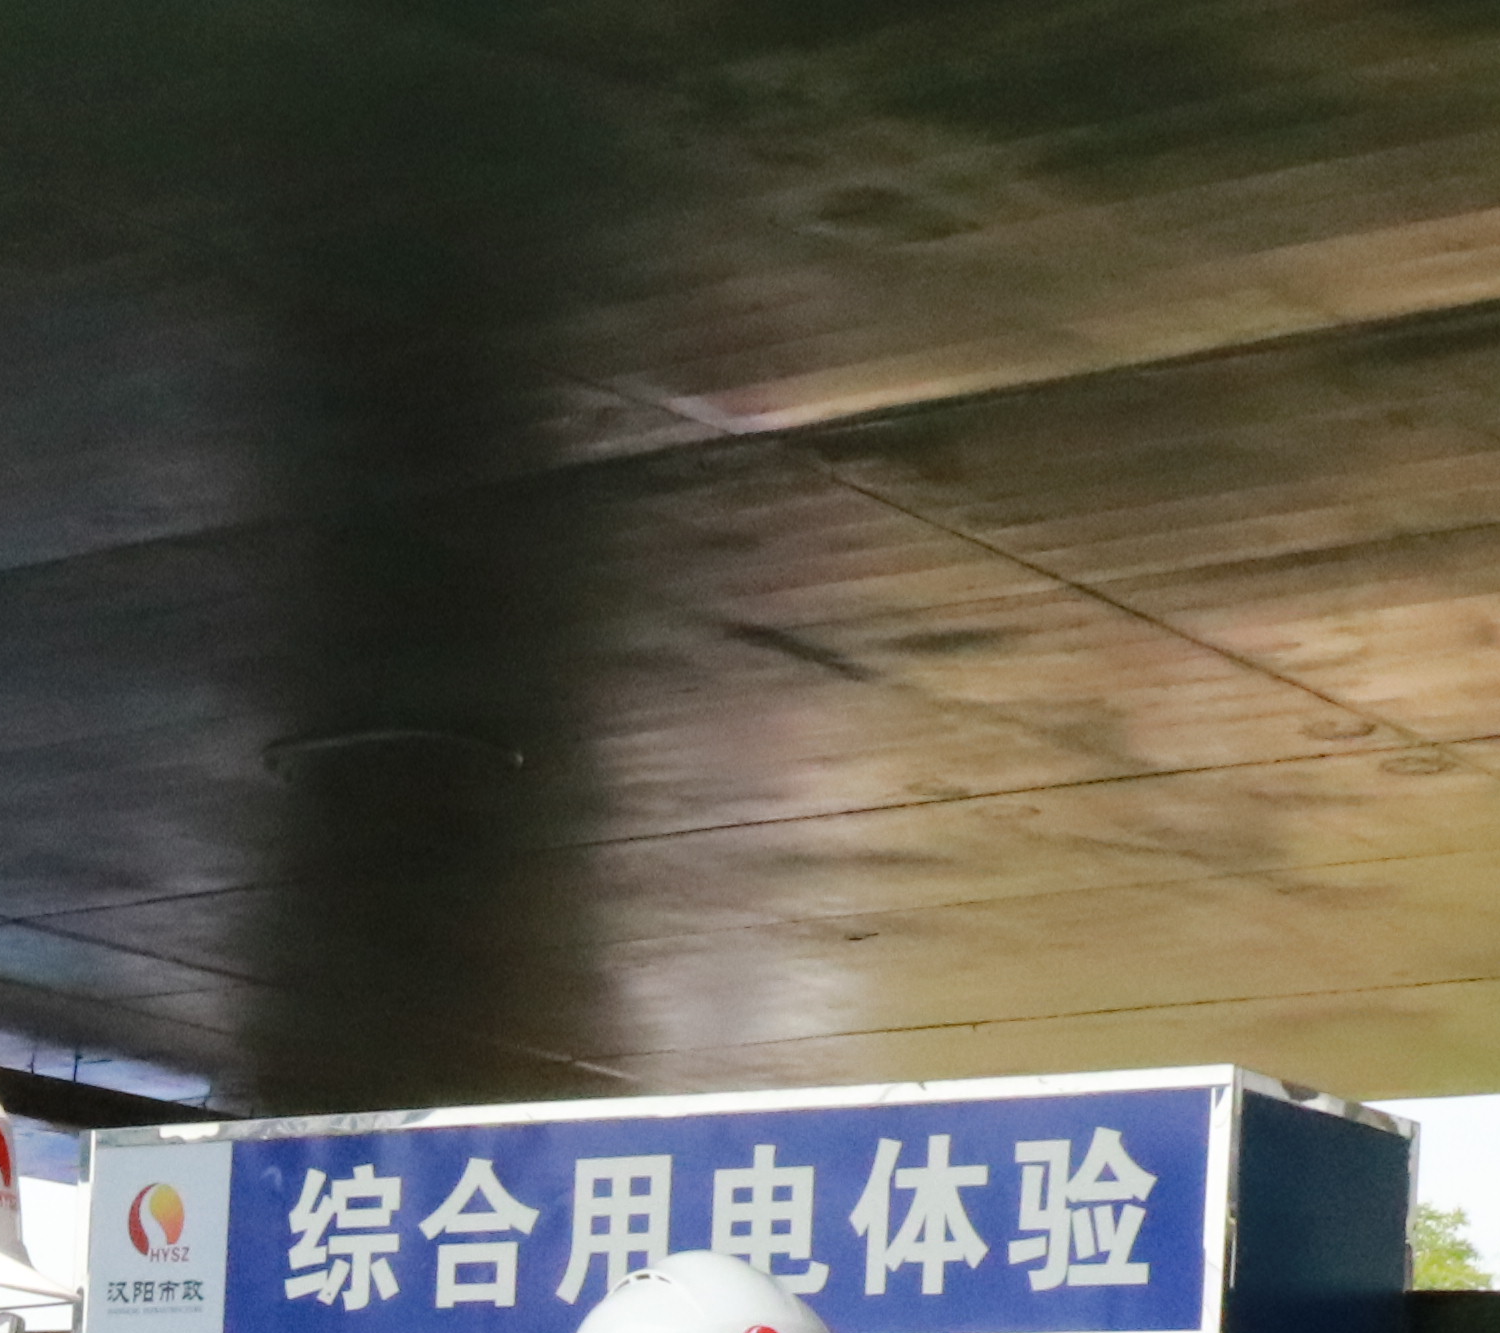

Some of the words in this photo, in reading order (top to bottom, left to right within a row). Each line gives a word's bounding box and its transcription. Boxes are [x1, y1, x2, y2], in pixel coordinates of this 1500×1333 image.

[284, 1126, 1157, 1311] 综合用电体验
[150, 1247, 190, 1263] HYSZ
[107, 1280, 204, 1304] 汉阳市政
